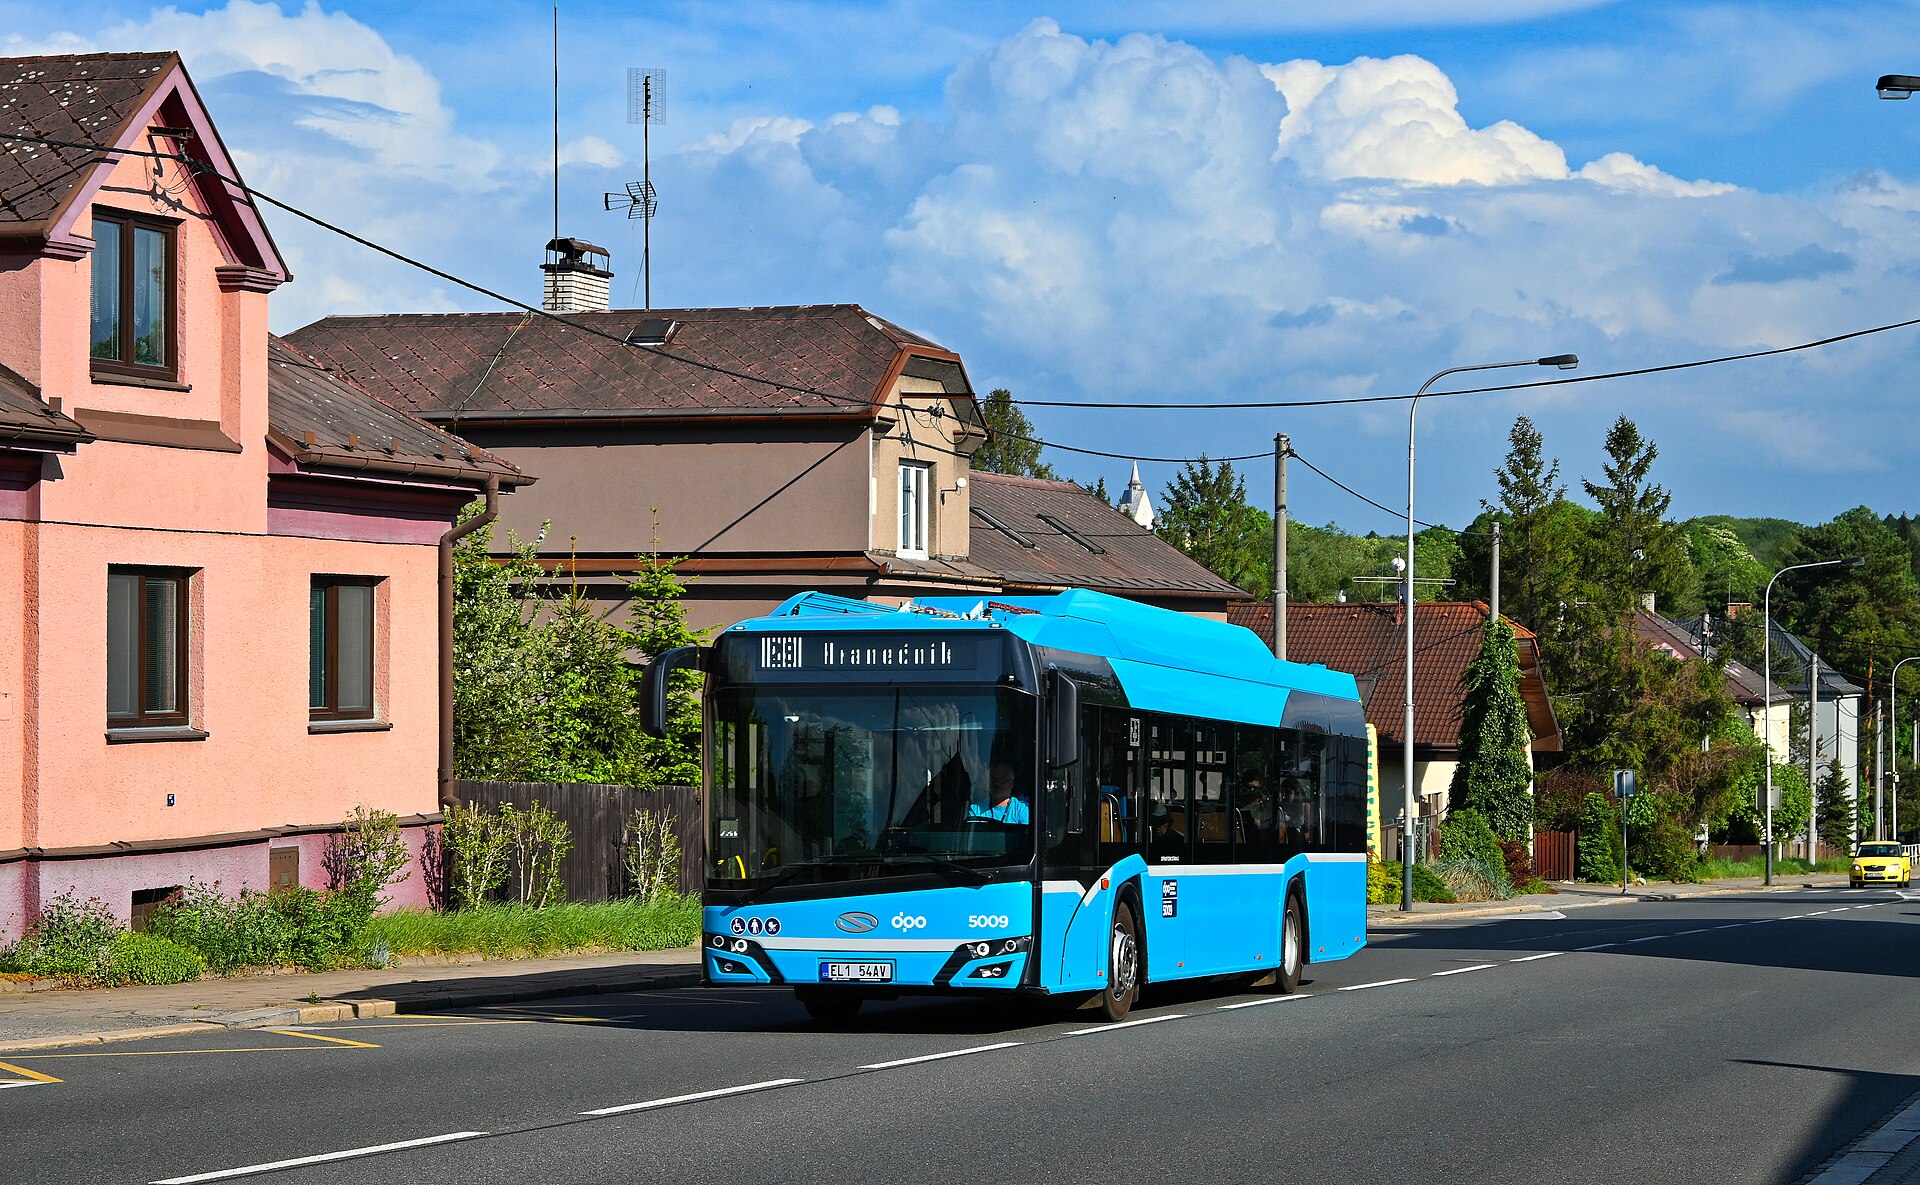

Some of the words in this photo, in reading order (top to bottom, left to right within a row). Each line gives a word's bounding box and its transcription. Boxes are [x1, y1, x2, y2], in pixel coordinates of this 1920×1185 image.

[891, 911, 927, 933] dpo
[968, 914, 1009, 929] 5009
[831, 964, 850, 977] EL1
[859, 965, 886, 977] 54AV
